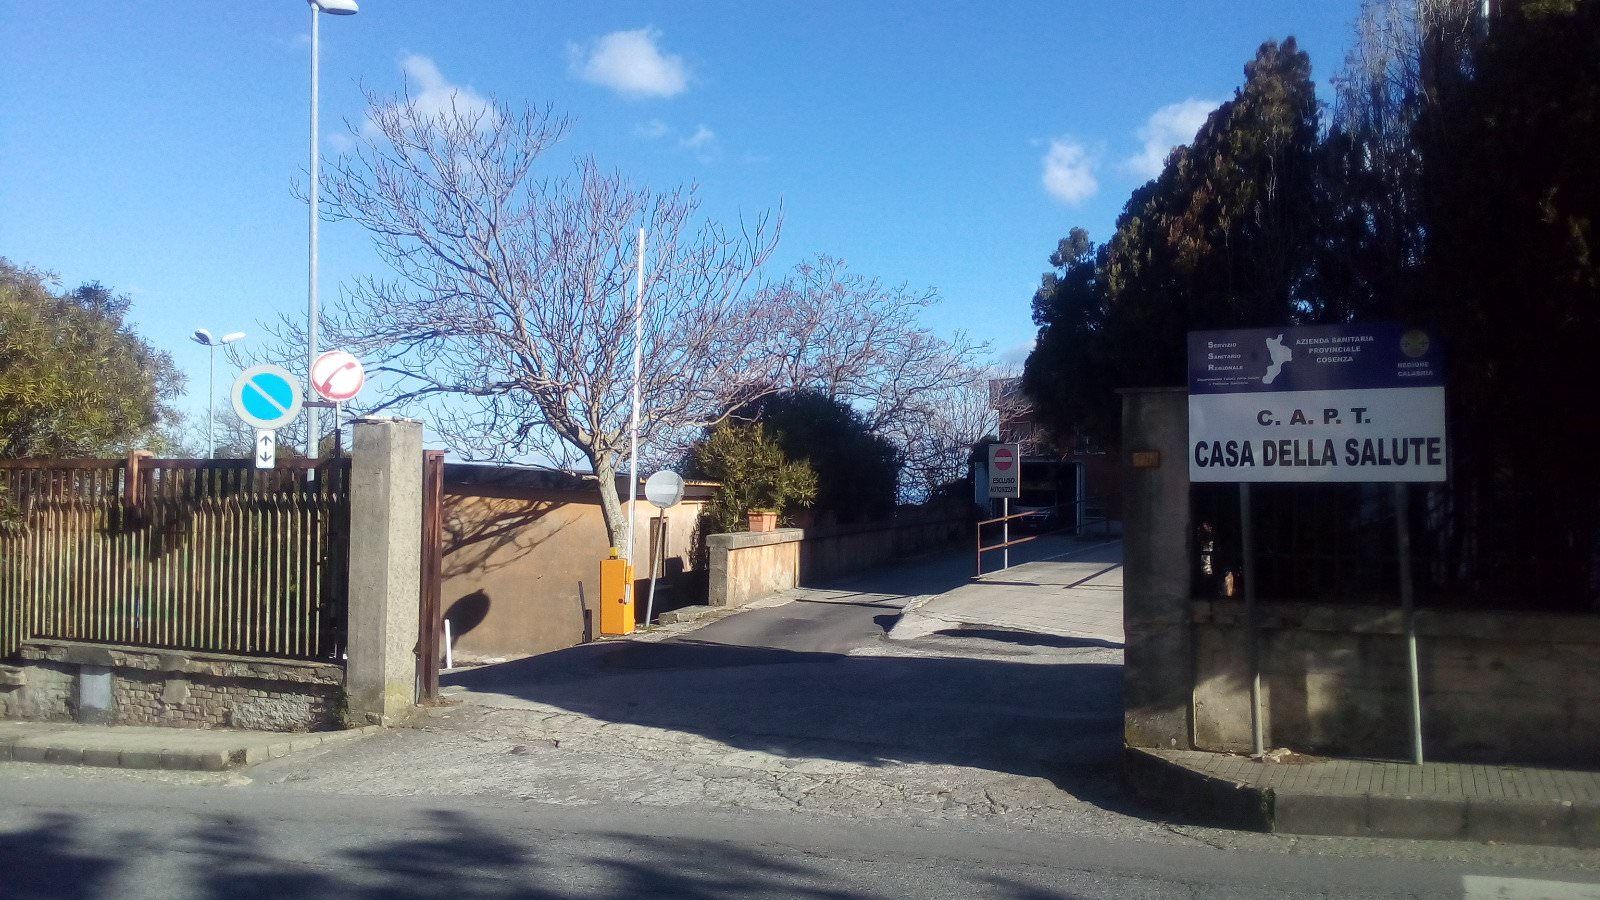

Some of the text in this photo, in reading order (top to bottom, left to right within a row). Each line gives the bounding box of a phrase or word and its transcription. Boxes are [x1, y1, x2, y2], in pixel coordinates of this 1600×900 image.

[1331, 335, 1374, 343] SANITARIA
[1308, 346, 1361, 354] PROVINCIALE
[1257, 407, 1371, 426] C. A. P. T.
[1194, 437, 1442, 467] CASA DELLA SALUTE
